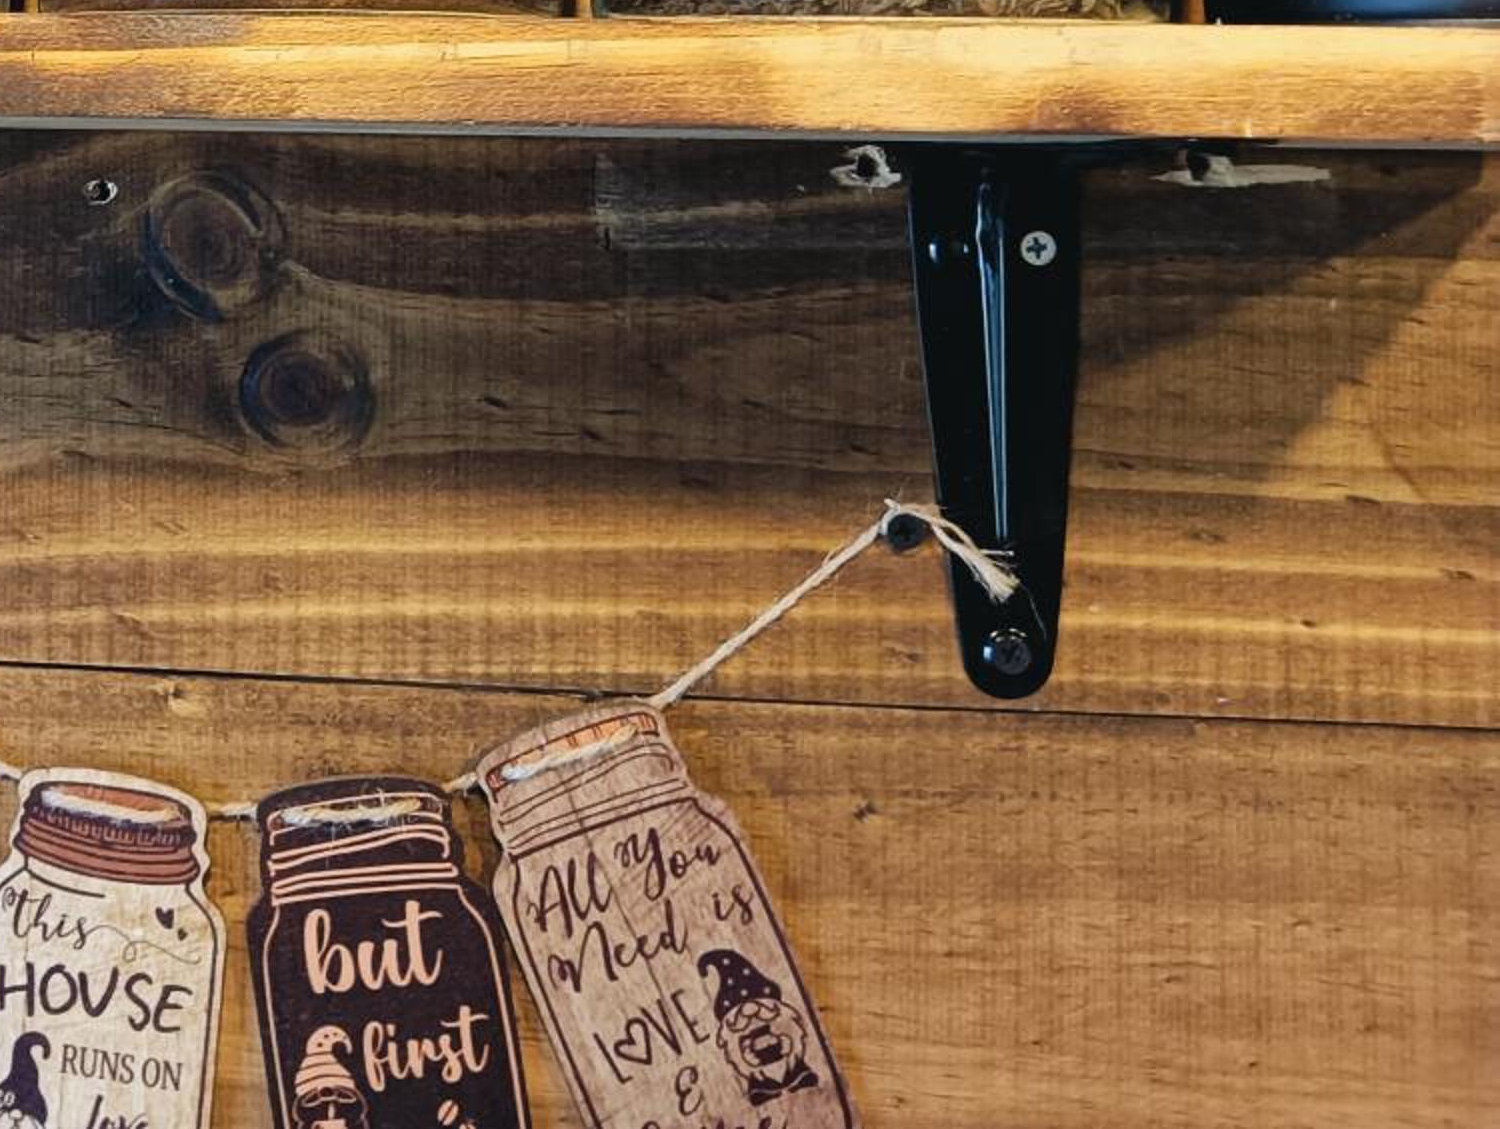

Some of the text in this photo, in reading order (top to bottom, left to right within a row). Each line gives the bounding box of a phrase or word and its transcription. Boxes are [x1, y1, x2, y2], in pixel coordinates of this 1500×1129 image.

[2, 885, 100, 953] this
[528, 826, 722, 935] All You
[304, 900, 444, 995] but
[547, 885, 755, 993] Need is
[60, 1043, 184, 1091] RUNS ON
[362, 1004, 490, 1092] first
